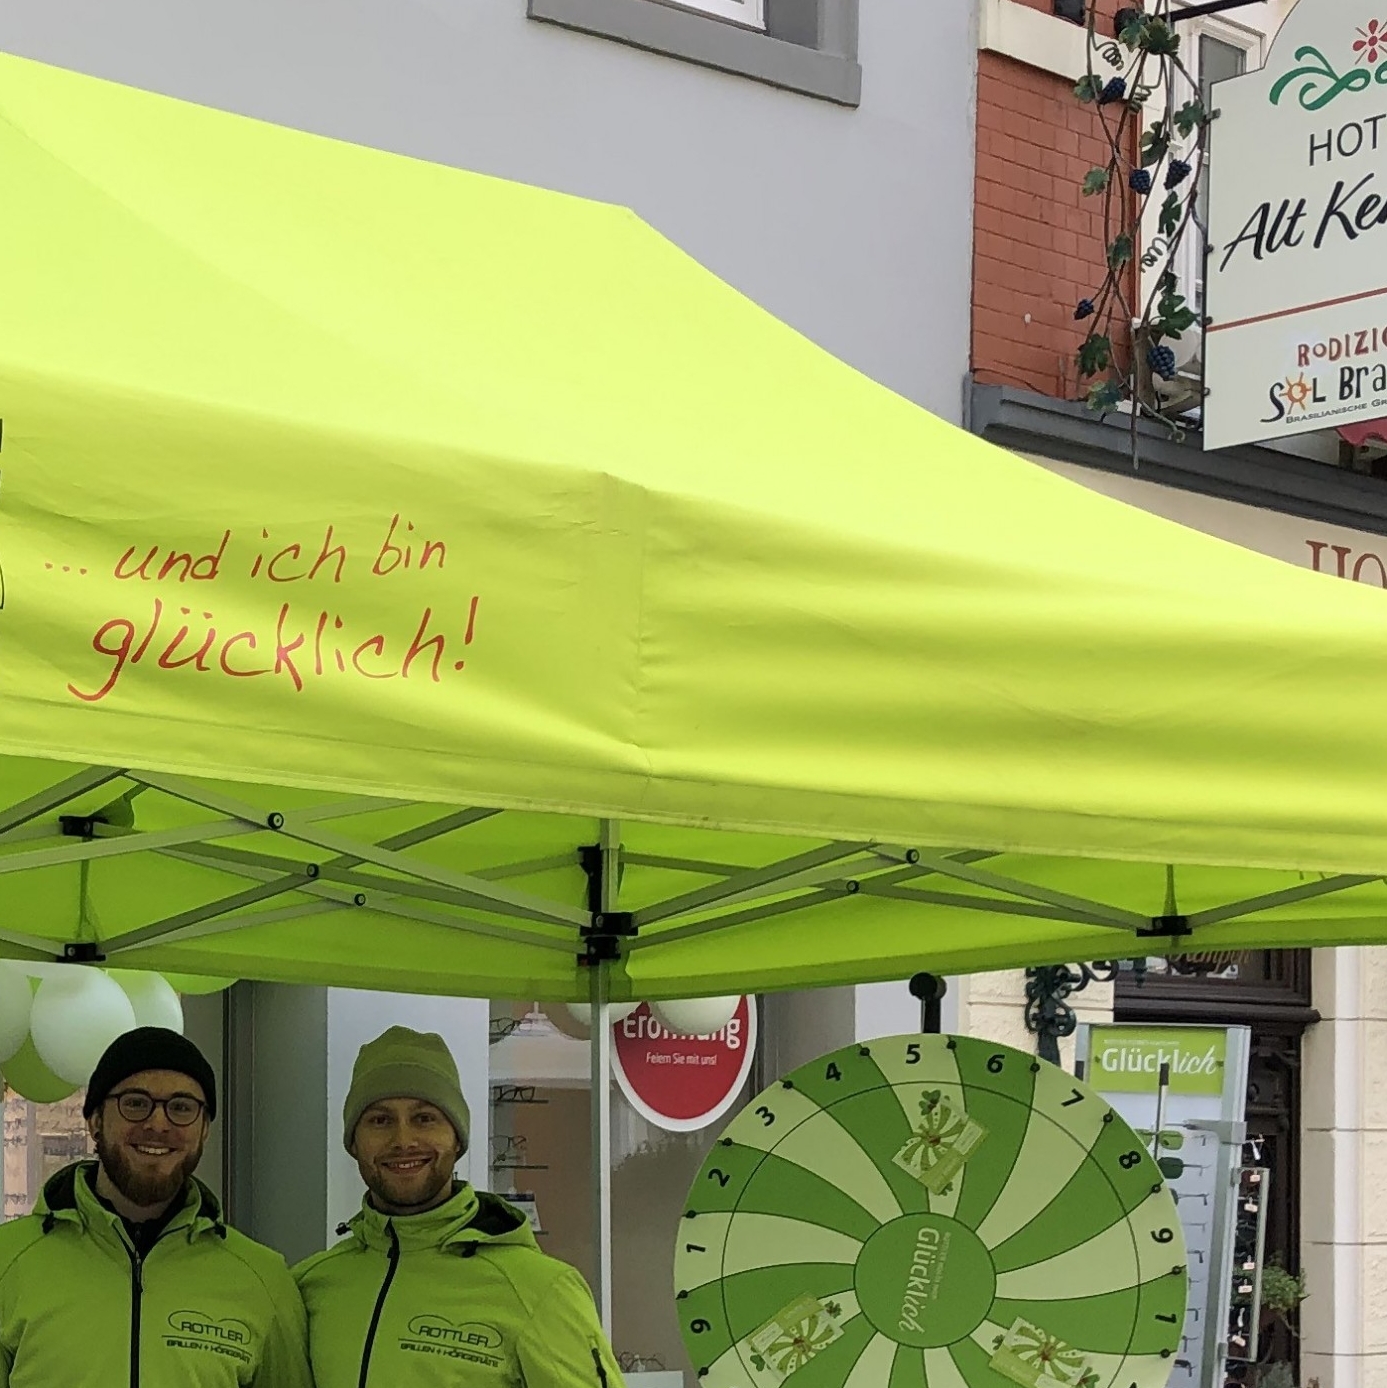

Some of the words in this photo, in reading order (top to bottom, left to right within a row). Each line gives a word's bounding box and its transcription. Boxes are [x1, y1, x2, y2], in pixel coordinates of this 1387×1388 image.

[1309, 113, 1387, 166] HOT
[1219, 197, 1307, 272] Alt
[114, 529, 231, 583] und
[251, 525, 347, 583] ich
[372, 513, 446, 576] bin
[67, 596, 479, 702] glücklich!
[673, 1053, 685, 1065] Sie
[686, 1053, 700, 1065] mit
[905, 1043, 921, 1065] 5
[1101, 1045, 1217, 1075] Glücklich
[825, 1061, 842, 1082] 4
[1061, 1088, 1085, 1107] 7
[755, 1106, 775, 1127] 3
[1118, 1150, 1142, 1170] 8
[707, 1168, 731, 1188] 2
[686, 1243, 706, 1253] 1
[898, 1227, 940, 1333] Glücklich
[1155, 1313, 1177, 1324] 1
[181, 1321, 243, 1344] ROTTLER
[419, 1325, 489, 1348] ROTTLER
[167, 1340, 202, 1351] BRILLEN
[400, 1342, 435, 1354] BRILLEN
